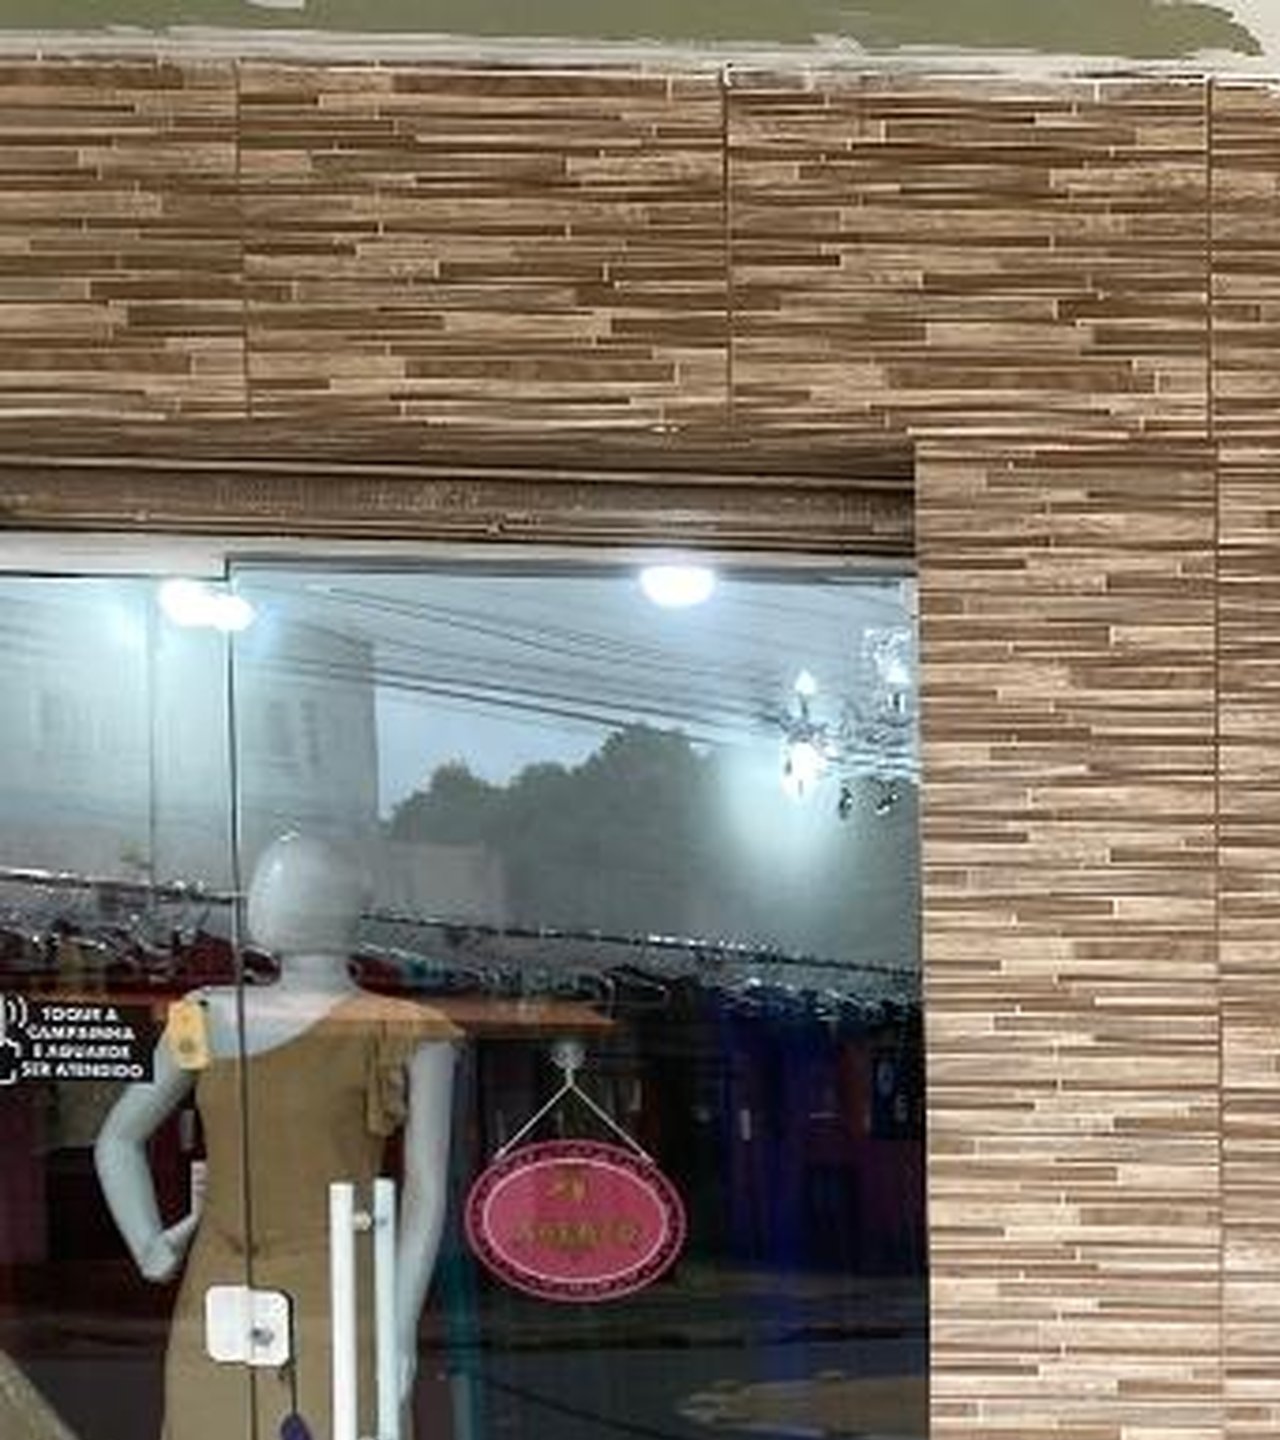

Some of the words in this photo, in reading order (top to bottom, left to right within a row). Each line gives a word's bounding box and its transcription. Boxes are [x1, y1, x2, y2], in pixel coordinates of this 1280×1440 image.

[42, 1007, 102, 1022] TOQUE
[105, 1008, 119, 1021] A
[21, 1060, 51, 1078] SER
[55, 1062, 145, 1079] ATENDIDO
